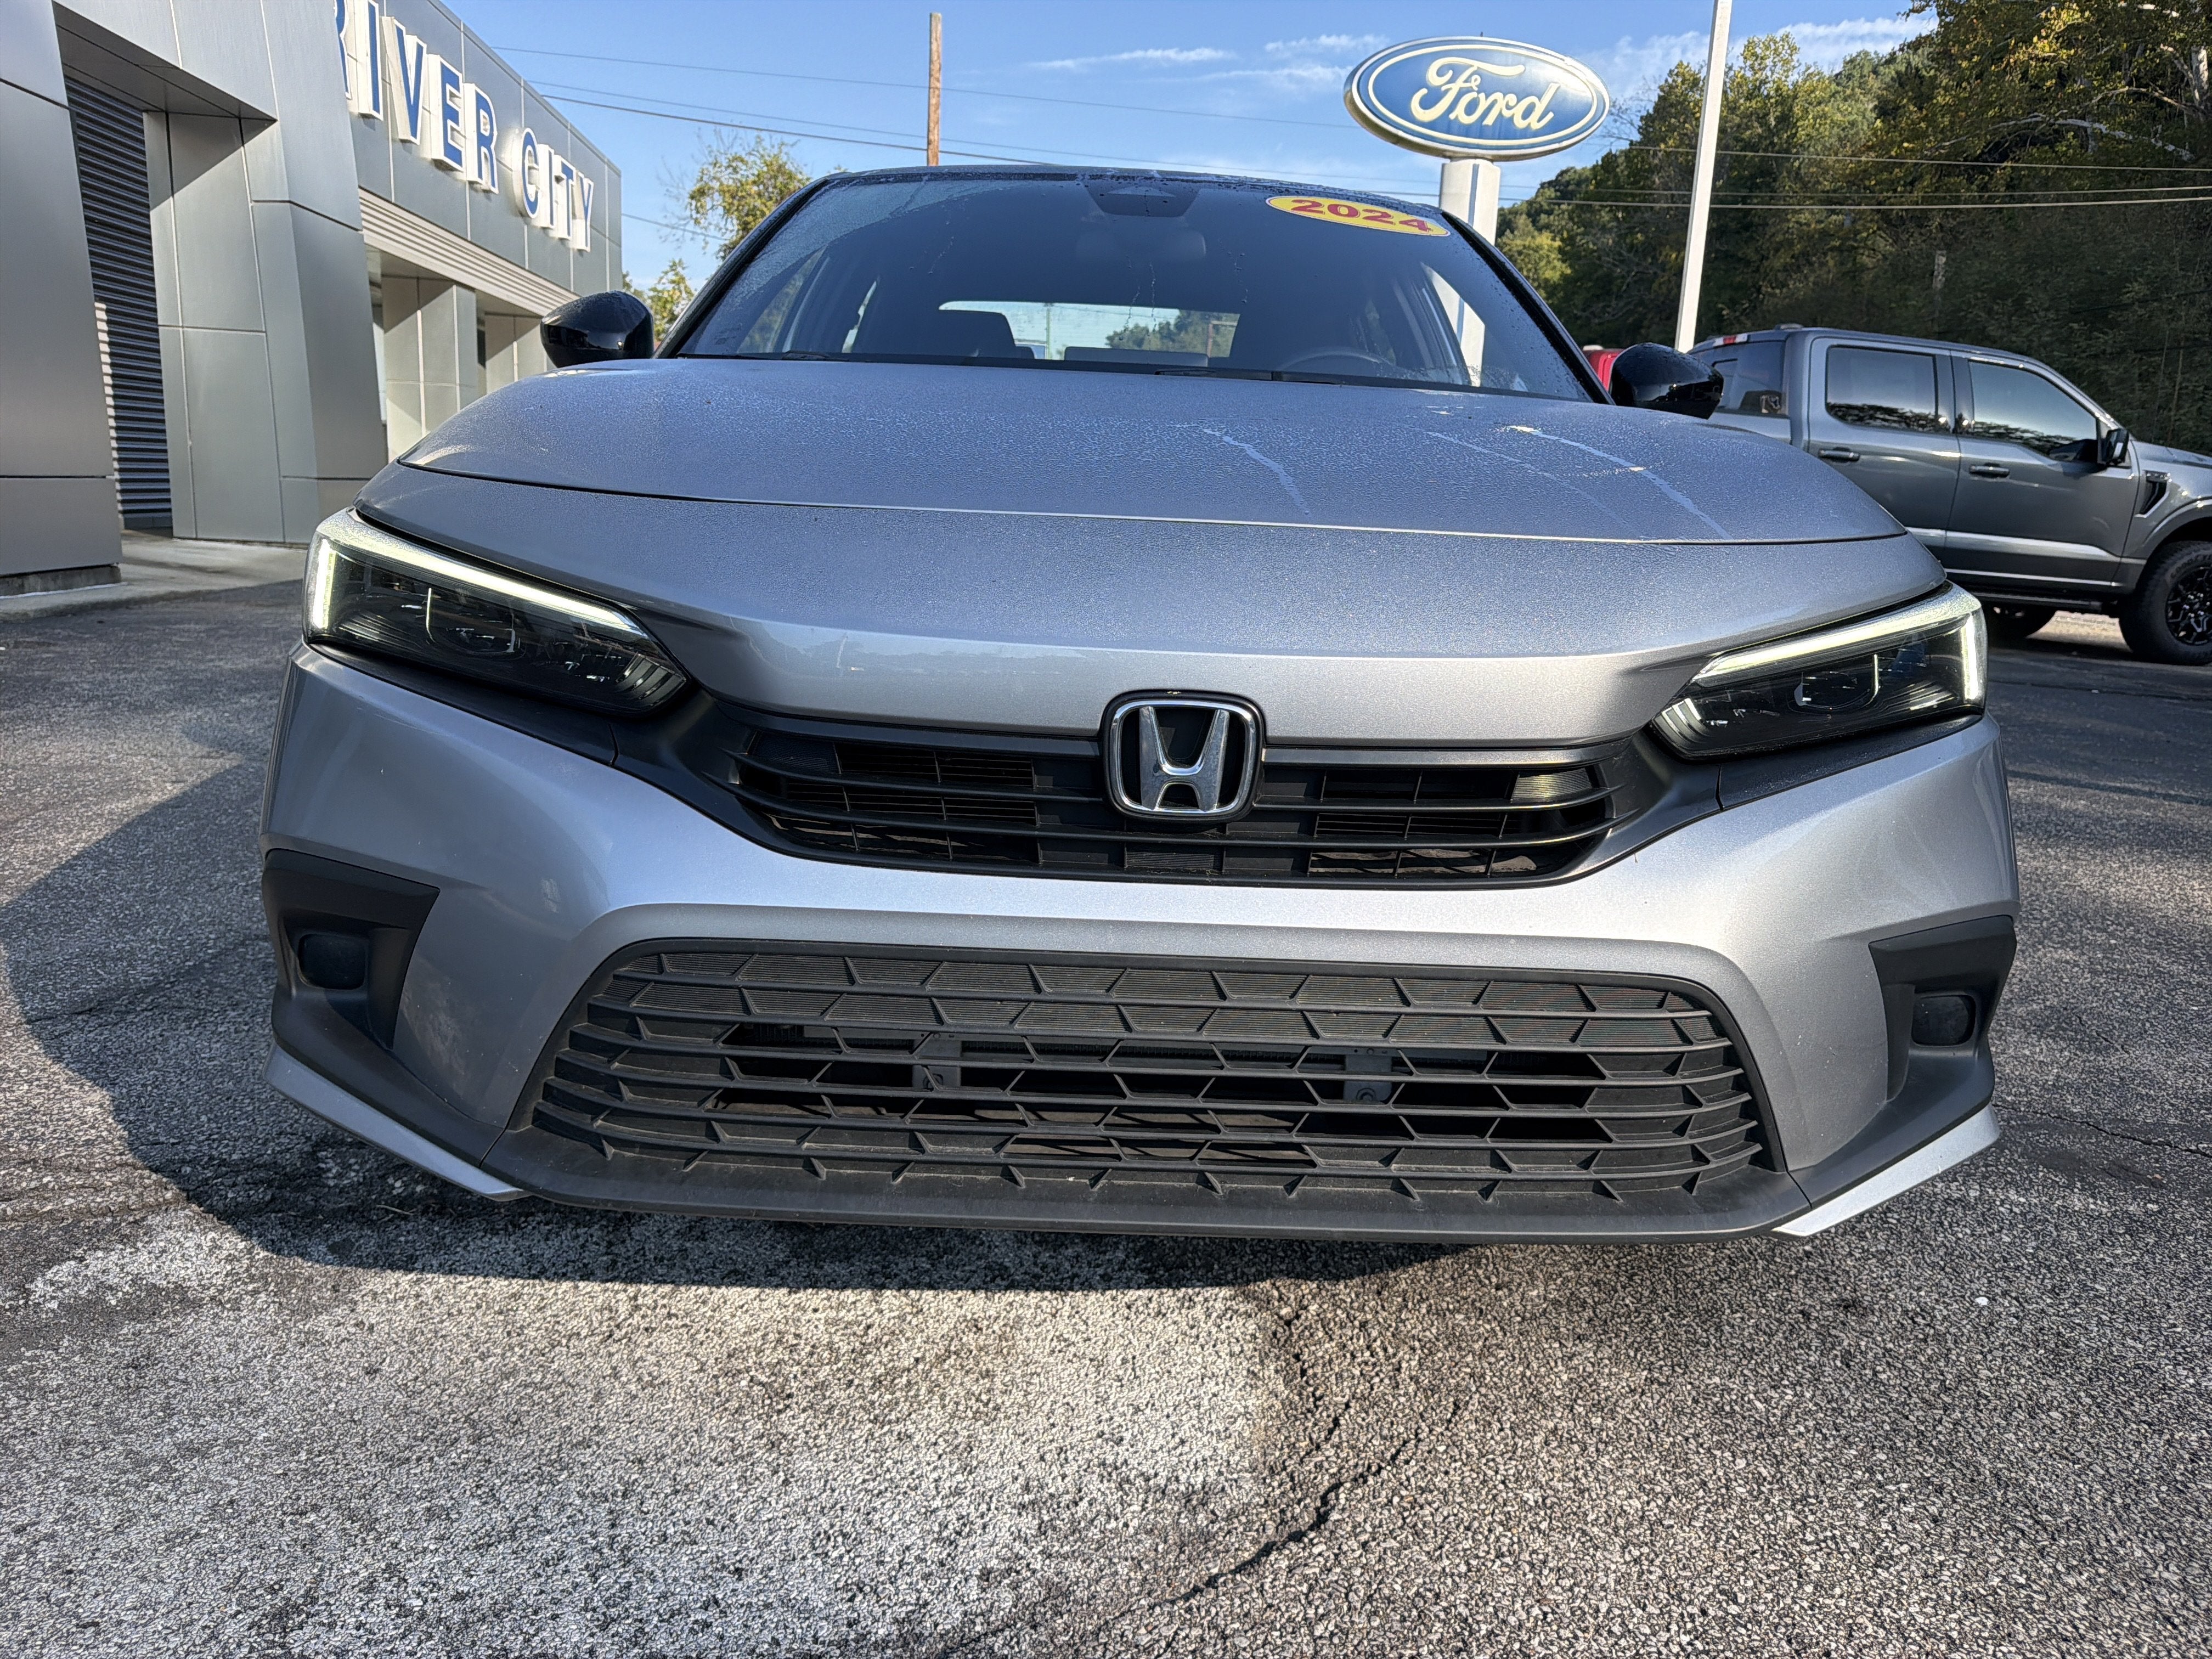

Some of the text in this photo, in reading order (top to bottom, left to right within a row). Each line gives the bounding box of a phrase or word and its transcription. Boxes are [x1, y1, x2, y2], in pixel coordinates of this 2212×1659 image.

[1410, 57, 1560, 130] Ford
[518, 127, 594, 252] CITY
[1290, 199, 1433, 233] 2024
